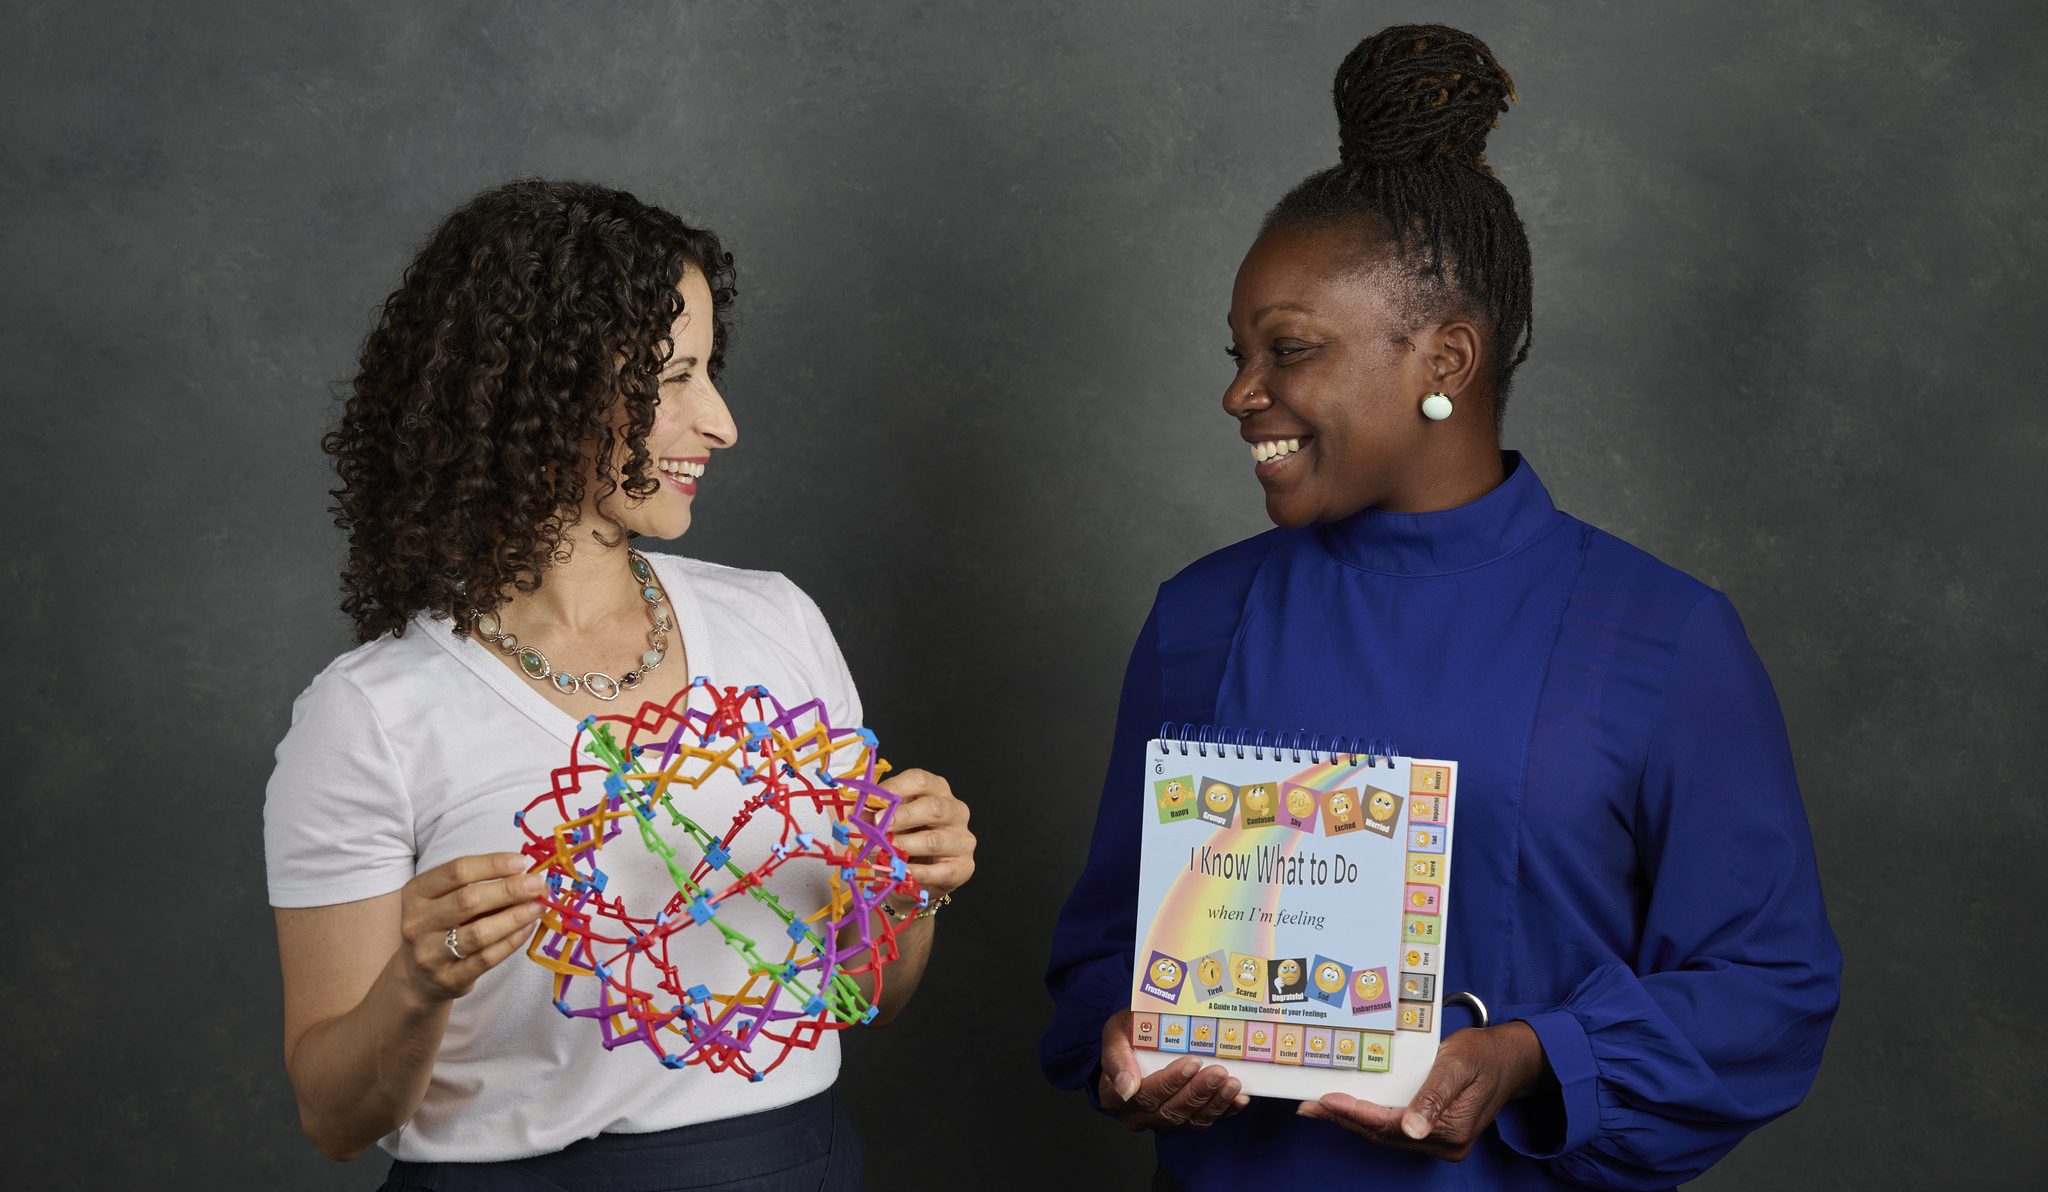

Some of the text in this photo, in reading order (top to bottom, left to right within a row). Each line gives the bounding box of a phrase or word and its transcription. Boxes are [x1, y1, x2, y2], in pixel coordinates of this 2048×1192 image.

[1170, 808, 1189, 818] Happy
[1202, 811, 1227, 825] Grumpy
[1246, 815, 1276, 826] Confused
[1290, 818, 1302, 828] Shy
[1365, 818, 1390, 833] Worried
[1334, 822, 1356, 832] Excited
[1190, 843, 1358, 886] I Know What to Do
[1208, 904, 1325, 931] when I'm feeling
[1145, 983, 1176, 1001] Frustrated
[1207, 985, 1224, 997] Tired
[1235, 987, 1257, 999] Scared
[1317, 991, 1329, 1001] Sad
[1271, 992, 1304, 1002] Ungrateful
[1208, 1002, 1213, 1010] A
[1213, 1003, 1230, 1011] Guide
[1231, 1004, 1238, 1012] to
[1239, 1004, 1257, 1014] Taking
[1258, 1006, 1280, 1014] Control
[1288, 1009, 1302, 1017] your
[1302, 1009, 1328, 1019] Feelings
[1352, 1001, 1392, 1014] Embarrassed
[1220, 1043, 1241, 1051] Confused
[1280, 1050, 1298, 1058] Excited
[1305, 1051, 1330, 1059] Frustrated
[1367, 1055, 1384, 1063] Happy
